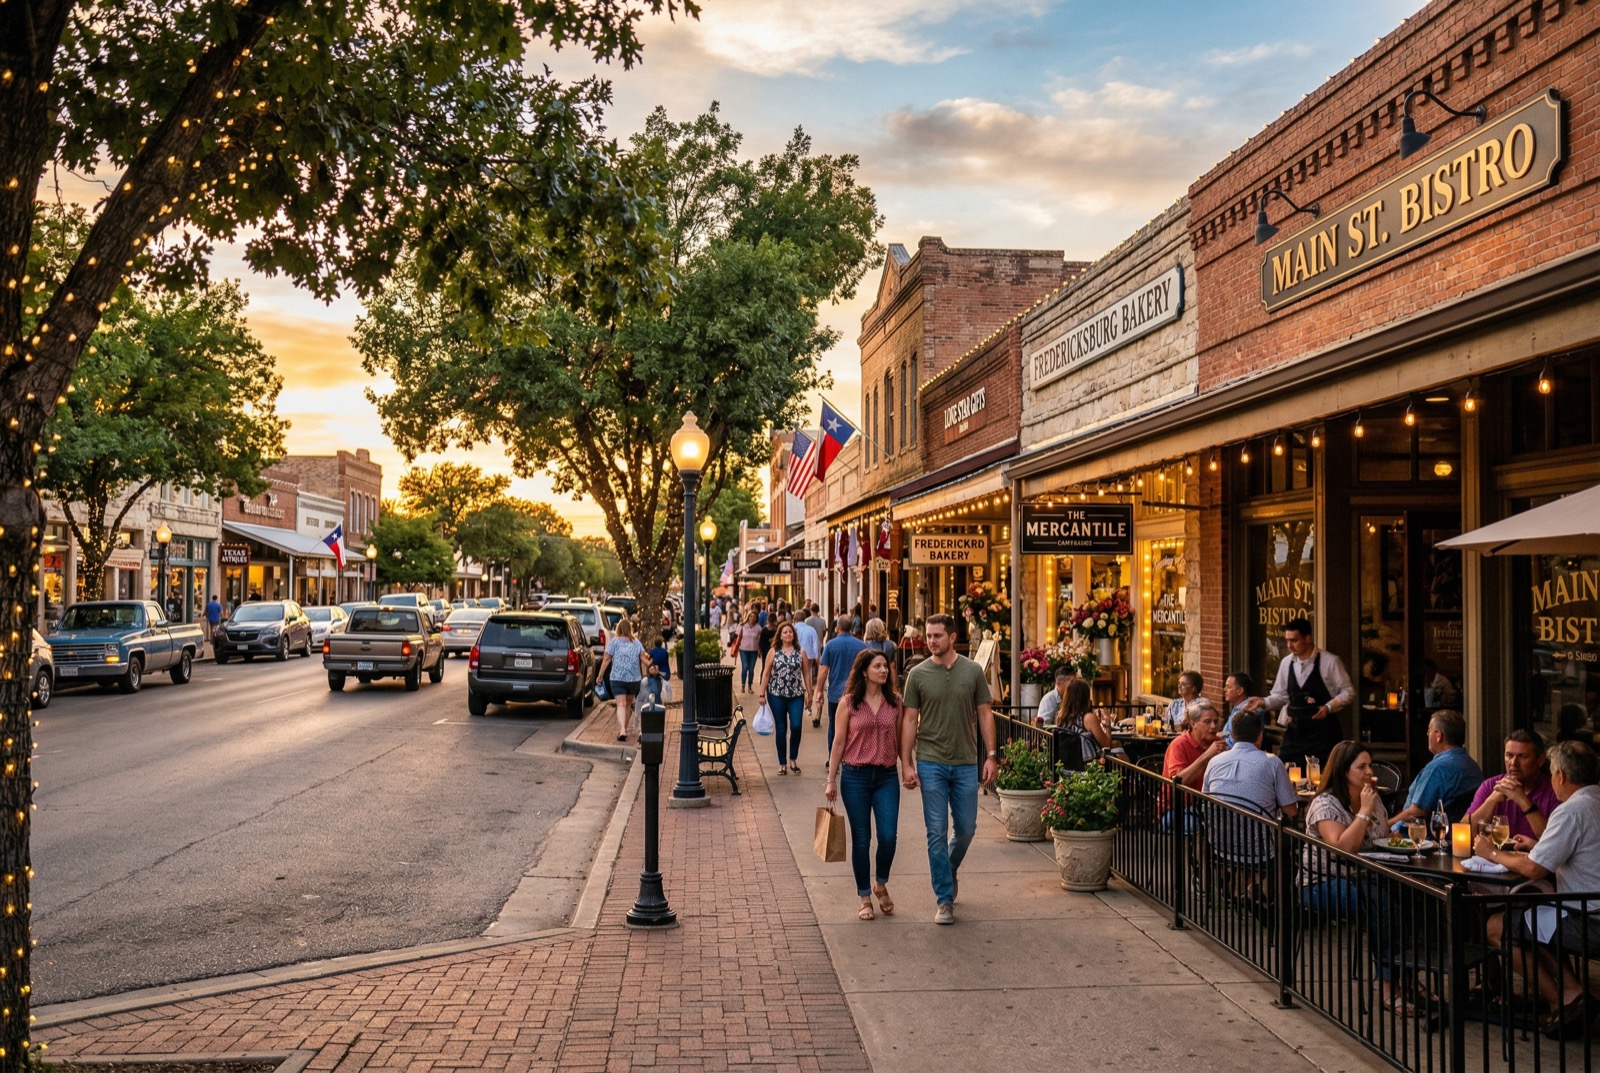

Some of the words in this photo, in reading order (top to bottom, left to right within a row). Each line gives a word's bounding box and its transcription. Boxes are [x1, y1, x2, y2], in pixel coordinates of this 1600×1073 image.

[1271, 223, 1339, 295] MAIN
[1348, 200, 1390, 258] ST.
[1399, 123, 1535, 235] BISTRO
[1033, 310, 1118, 381] FREDERICKSBURG
[1121, 277, 1172, 335] BAKERY
[1067, 510, 1086, 520] THE
[1026, 521, 1127, 537] MERCANTILE
[914, 538, 985, 549] FREDERICKRD
[223, 549, 246, 557] TEXAS
[929, 550, 970, 560] BAKERY
[1255, 576, 1291, 606] MAIN
[1293, 577, 1312, 606] ST.
[1530, 569, 1600, 615] MAIN
